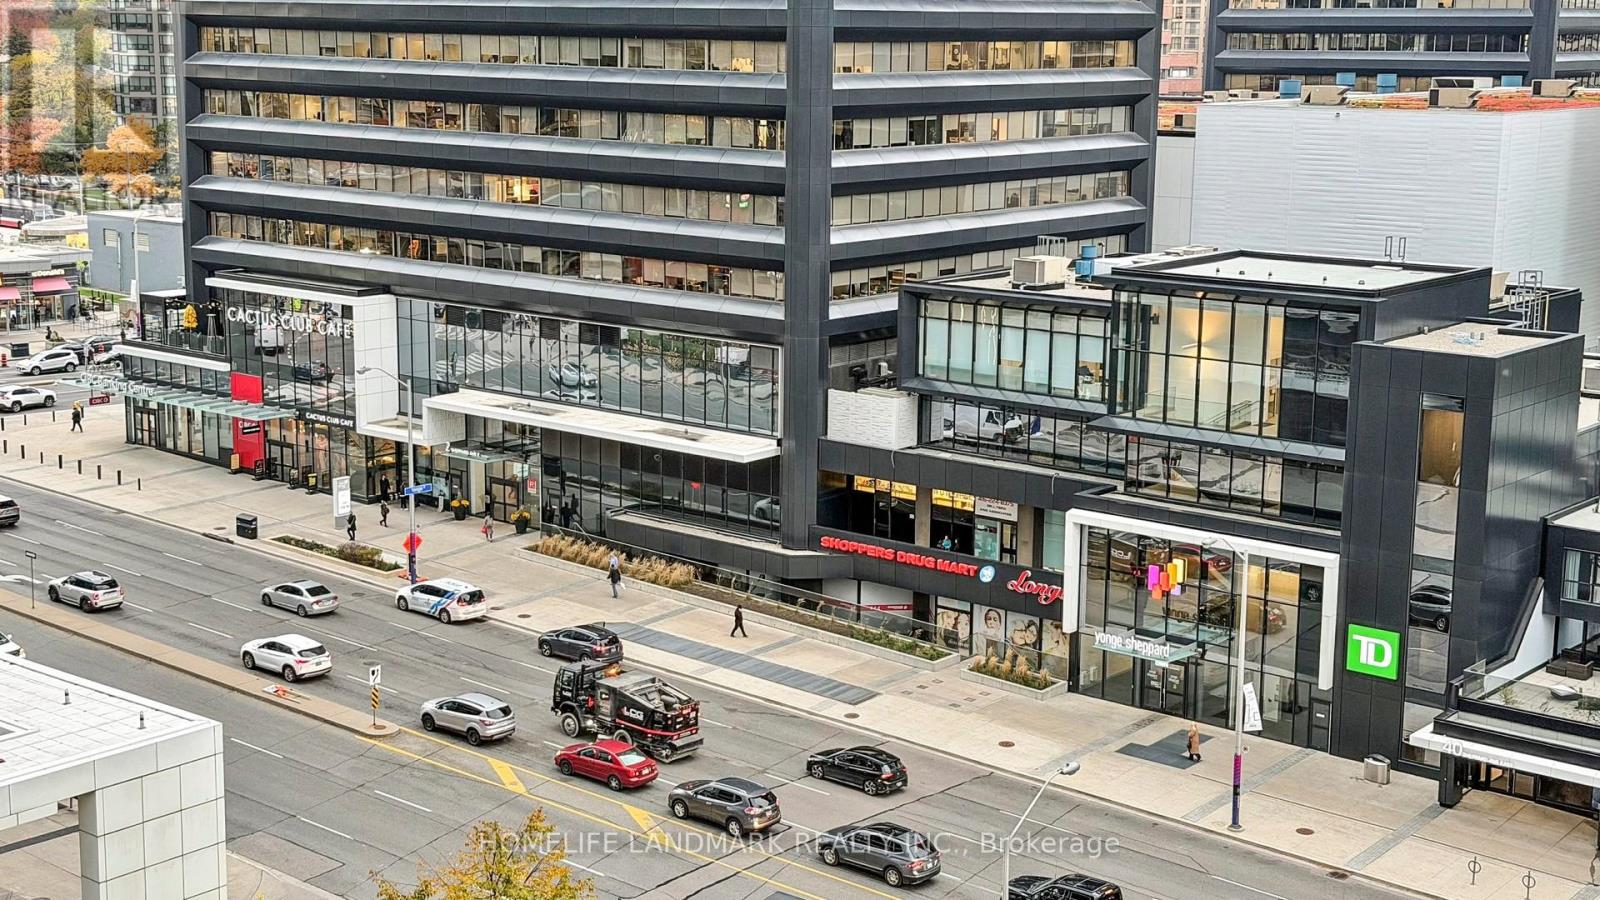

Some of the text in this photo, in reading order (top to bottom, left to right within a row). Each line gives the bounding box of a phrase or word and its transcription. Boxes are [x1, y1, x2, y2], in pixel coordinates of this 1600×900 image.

[227, 307, 351, 339] CACTUS CLUB CAFE
[305, 412, 354, 427] CACTUS CLUB CAFE
[820, 536, 979, 577] SHOPPERS DRUG MART
[1007, 570, 1064, 604] Long
[1094, 631, 1170, 657] yonge sheppard
[1352, 634, 1393, 668] TD
[1442, 741, 1463, 756] 40
